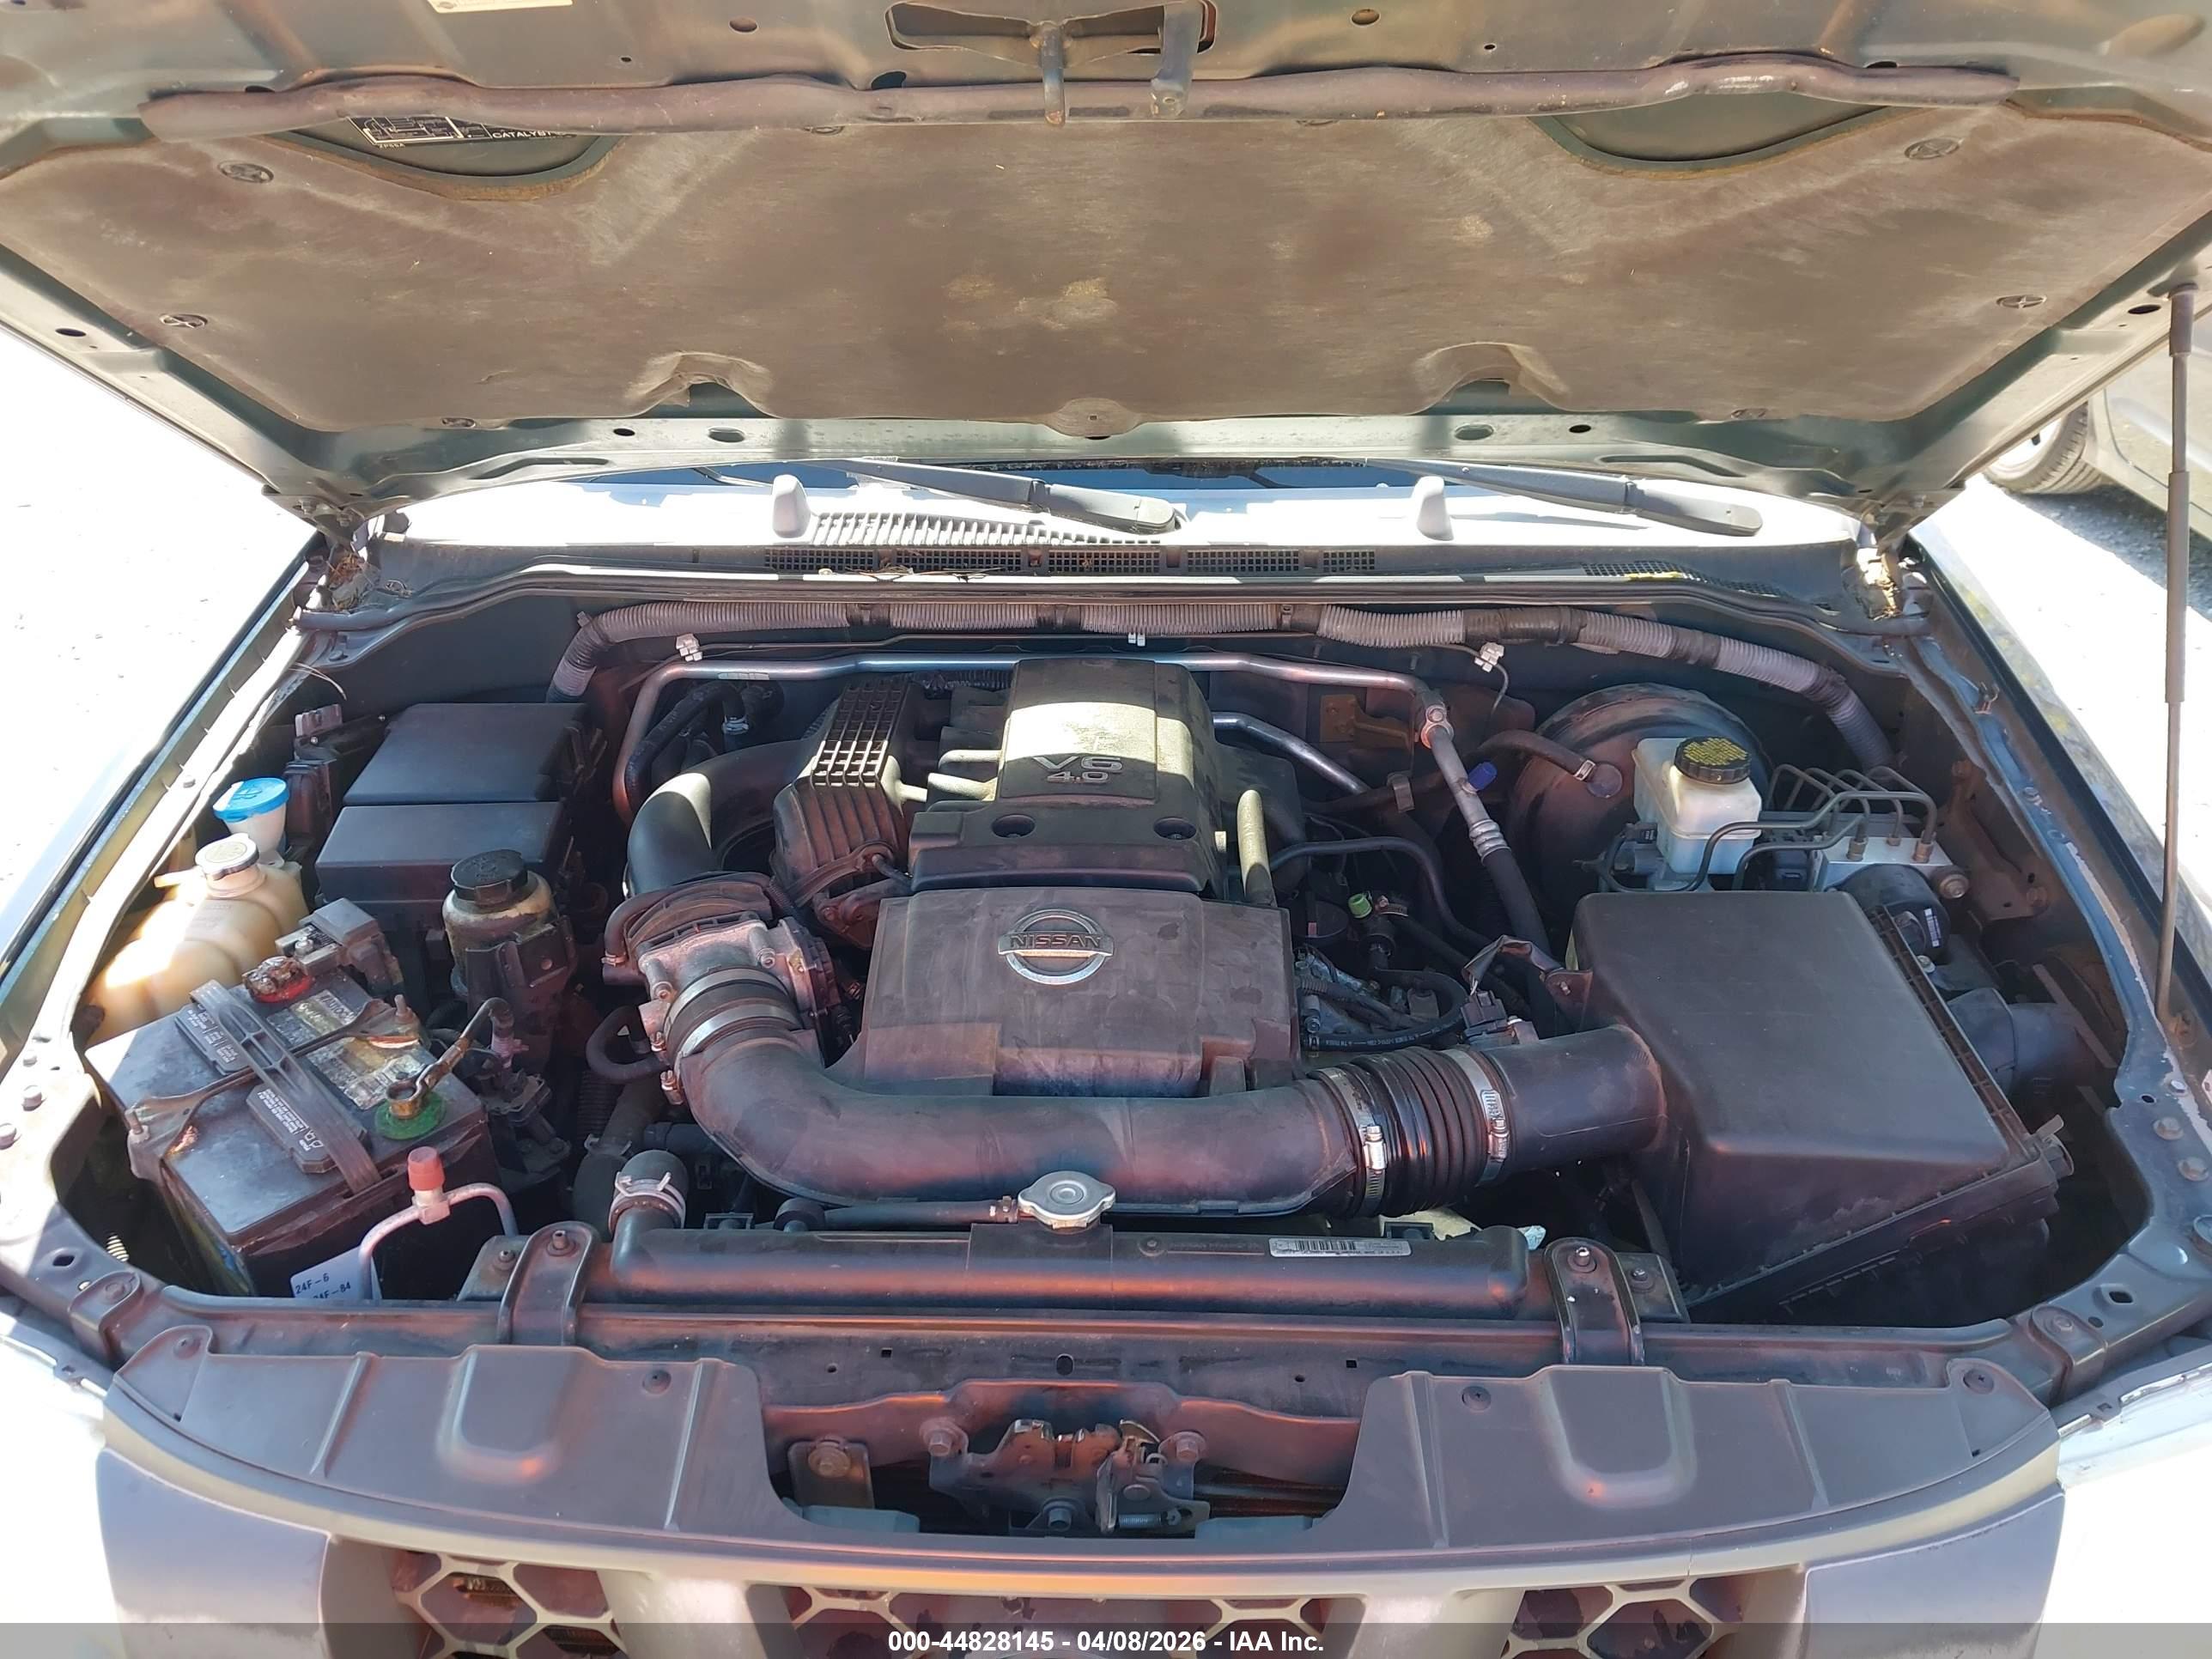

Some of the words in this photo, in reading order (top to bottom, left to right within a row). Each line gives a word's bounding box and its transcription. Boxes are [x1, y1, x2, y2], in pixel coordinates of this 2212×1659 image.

[1032, 756, 1123, 773] V6
[1047, 771, 1109, 783] 4.0
[1010, 933, 1101, 949] NISSAN
